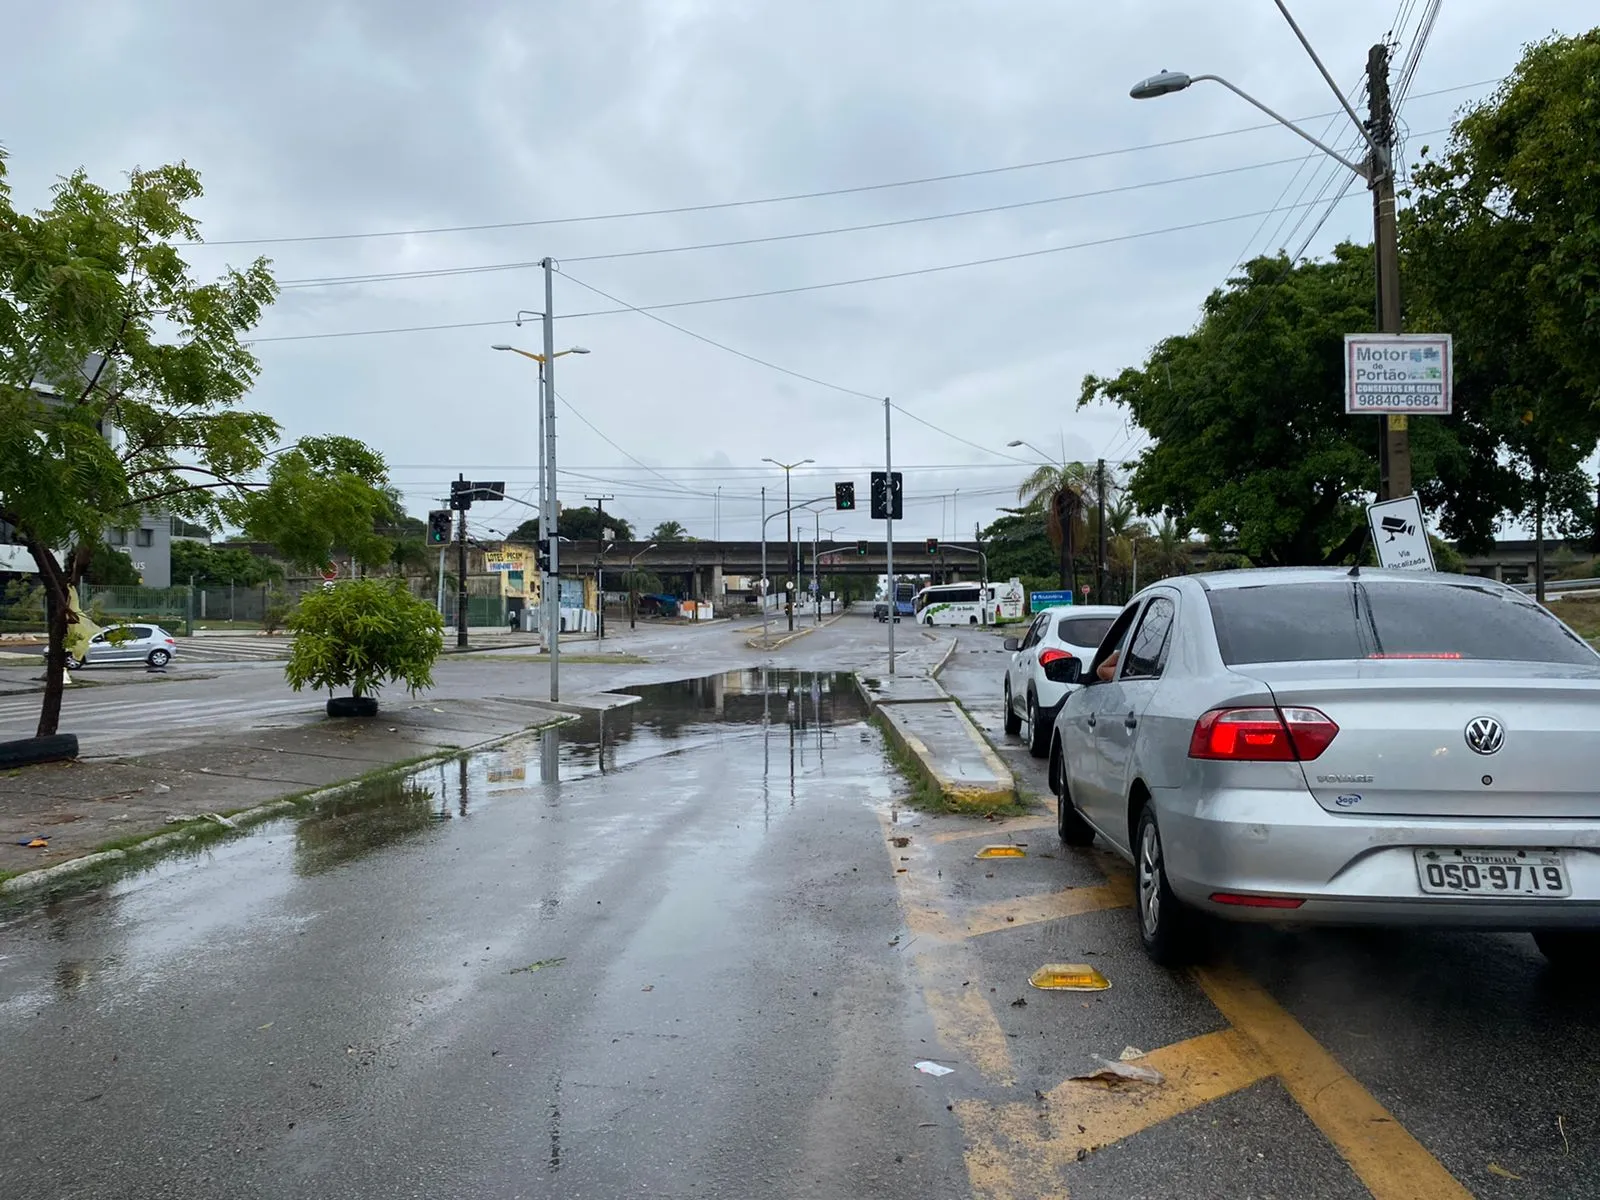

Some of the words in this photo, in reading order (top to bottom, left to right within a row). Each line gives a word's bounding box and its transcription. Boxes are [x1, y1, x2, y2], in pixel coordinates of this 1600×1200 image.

[1357, 347, 1407, 360] Motor
[1357, 369, 1406, 380] Portão
[1357, 384, 1403, 393] CONSERTOS
[1404, 384, 1415, 393] EM
[1416, 384, 1441, 393] GERAL
[1359, 395, 1438, 406] 98840-6684
[487, 553, 504, 562] LOTES
[1398, 550, 1411, 558] Via
